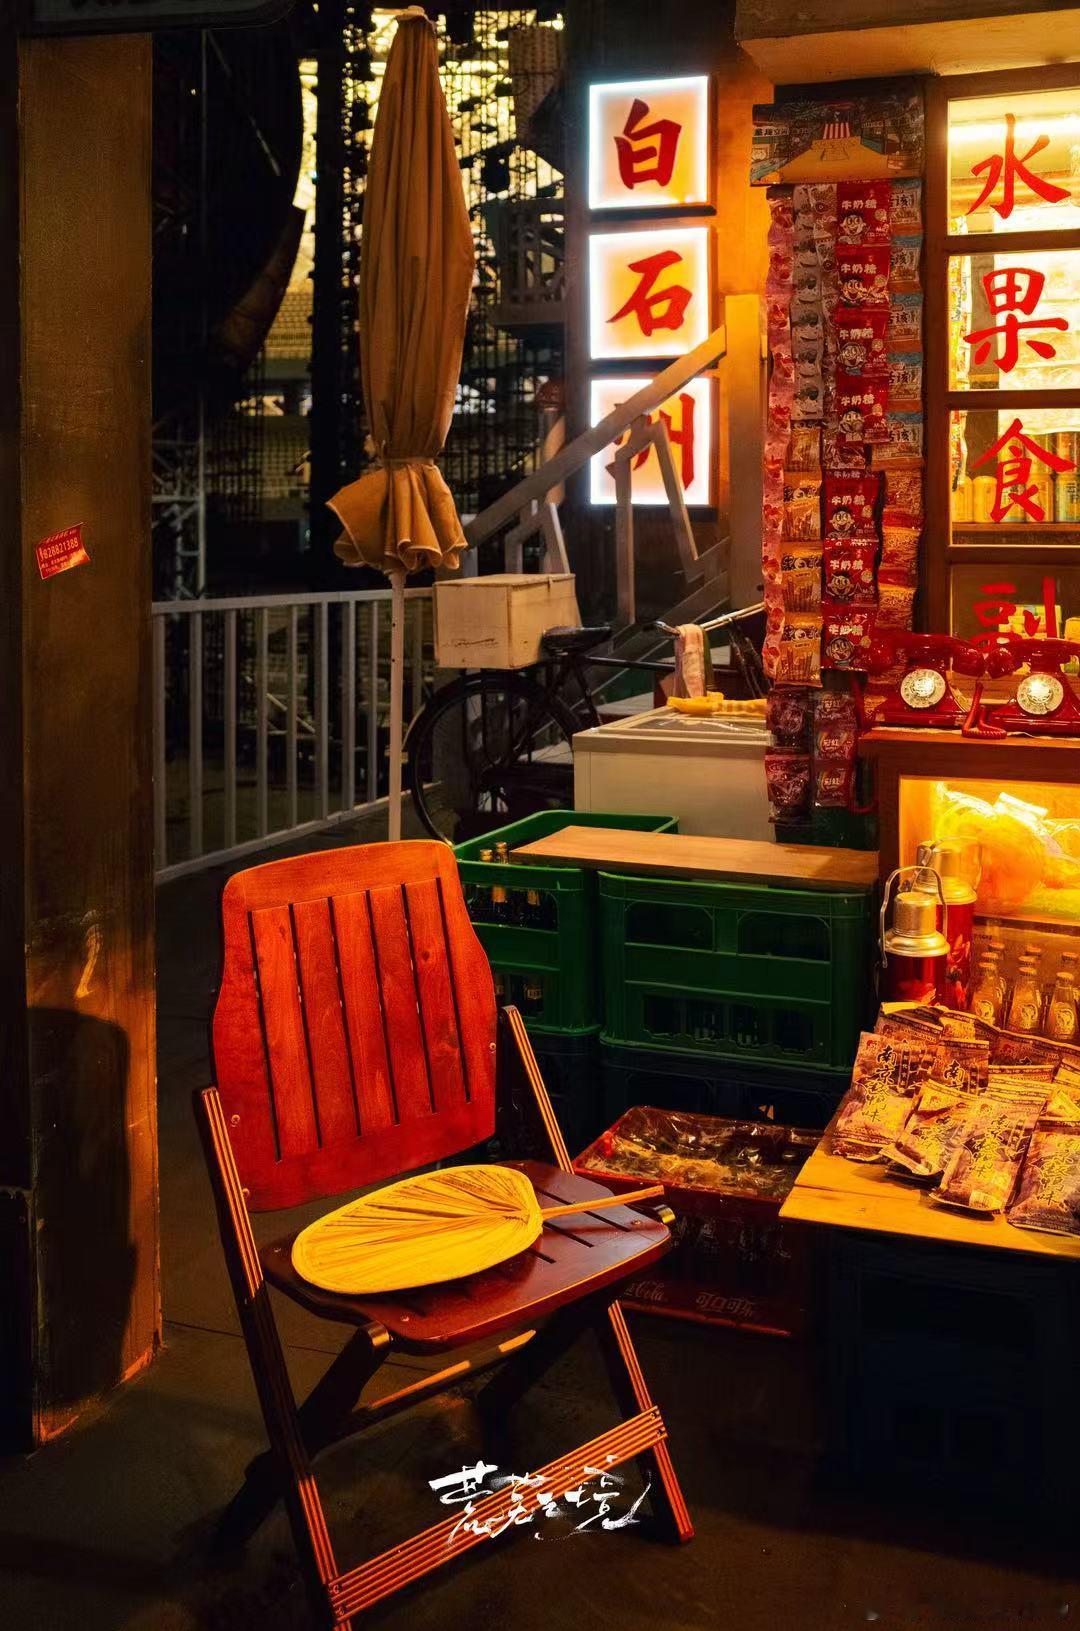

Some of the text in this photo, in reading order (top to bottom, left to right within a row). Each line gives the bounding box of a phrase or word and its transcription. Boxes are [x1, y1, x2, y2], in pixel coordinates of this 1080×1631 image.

[841, 199, 878, 210] 牛奶糖
[840, 263, 878, 275] 牛奶糖
[839, 327, 874, 340] 牛奶糖
[840, 393, 875, 406] 牛奶糖
[831, 494, 866, 506] 牛奶糖
[829, 559, 864, 571] 牛奶糖
[828, 623, 864, 636] 牛奶糖
